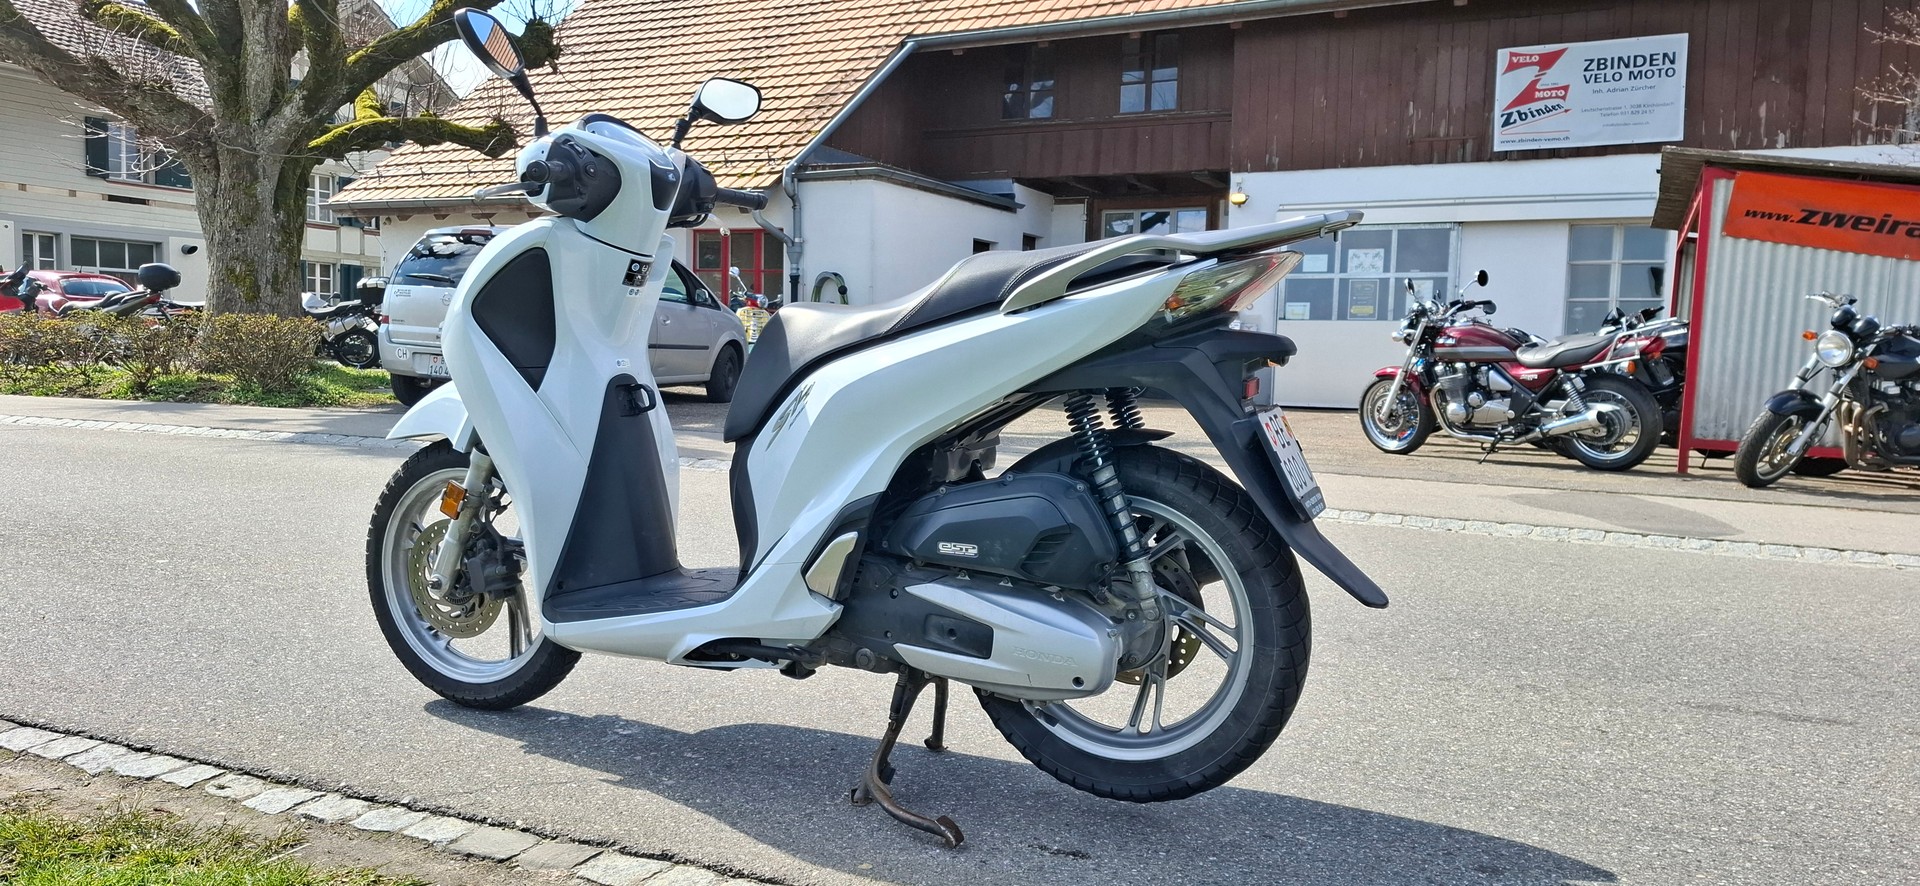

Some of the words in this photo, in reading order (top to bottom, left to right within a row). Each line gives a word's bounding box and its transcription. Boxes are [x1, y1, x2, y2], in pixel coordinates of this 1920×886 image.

[1512, 55, 1540, 63] VELO
[1583, 51, 1676, 72] ZBINDEN
[1583, 71, 1623, 84] VELO
[1628, 67, 1676, 81] MOTO
[1535, 90, 1565, 98] MOTO
[1500, 103, 1564, 128] Zbinden
[1500, 136, 1570, 144] www.zbinden-vemo.ch
[397, 348, 408, 359] CH
[1269, 414, 1291, 449] BE
[1012, 645, 1079, 667] HONDA
